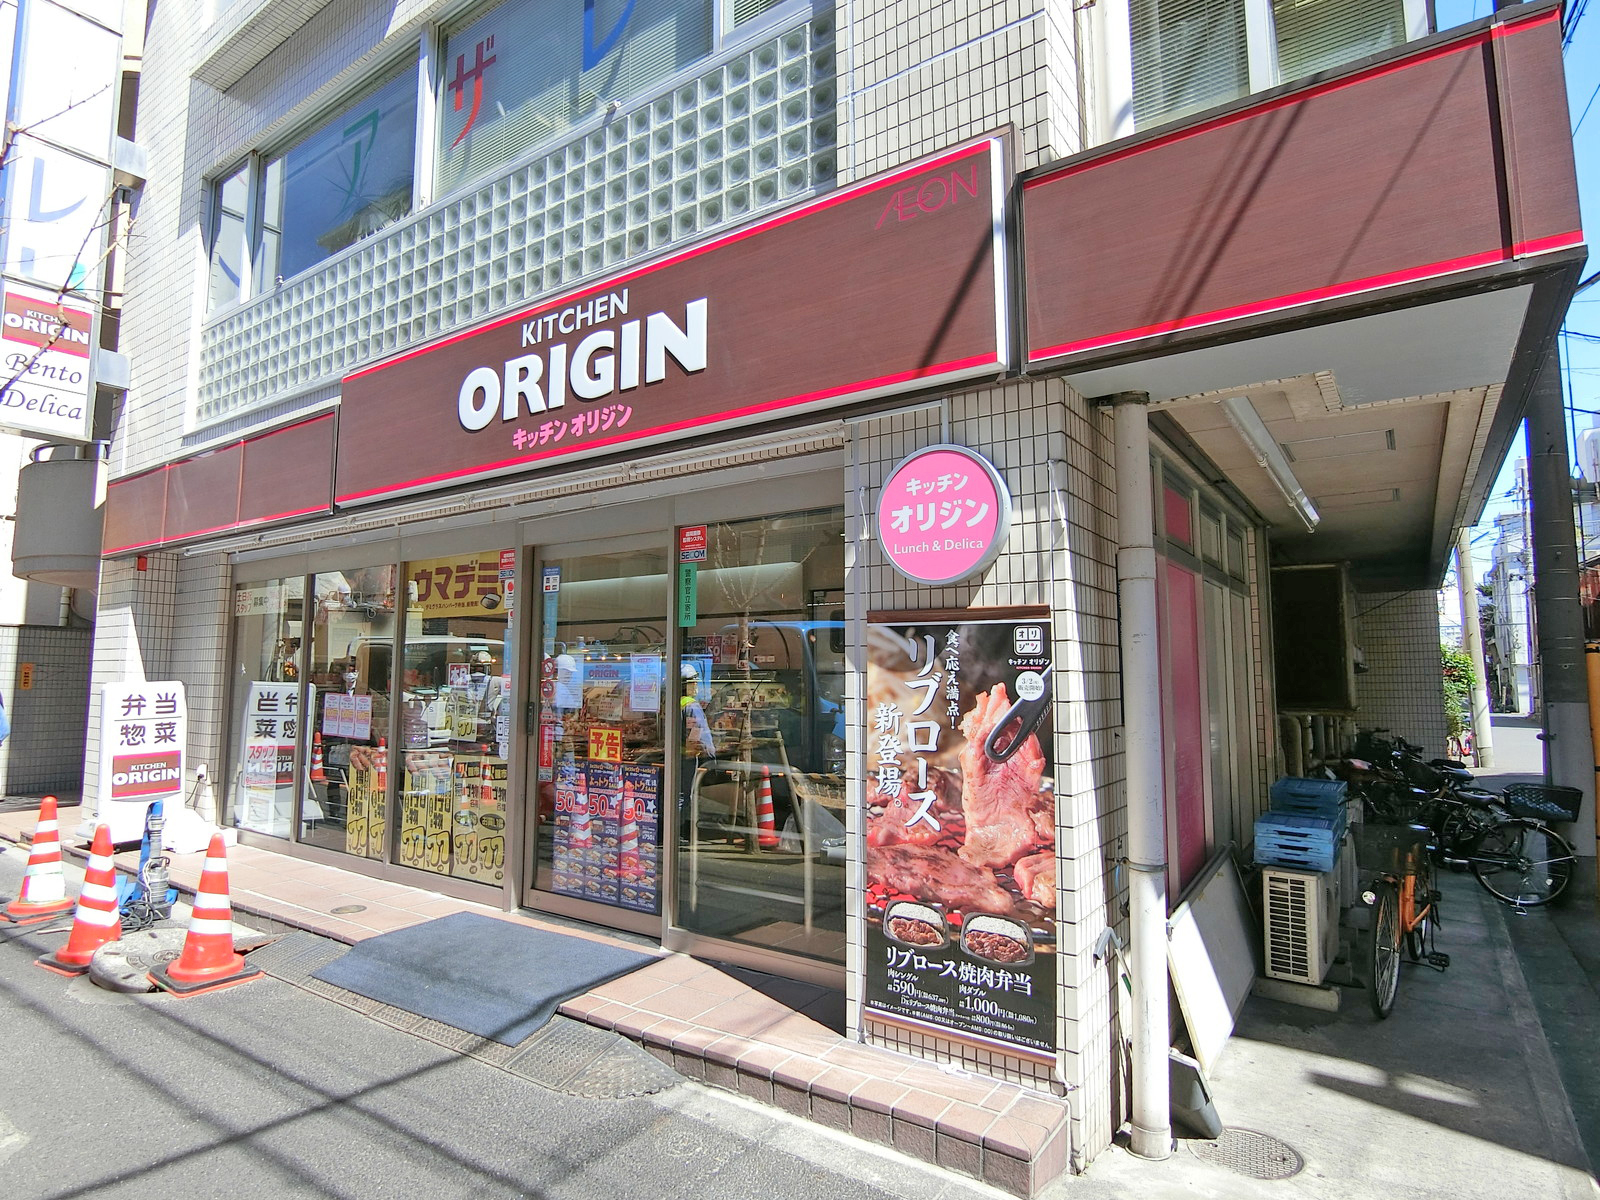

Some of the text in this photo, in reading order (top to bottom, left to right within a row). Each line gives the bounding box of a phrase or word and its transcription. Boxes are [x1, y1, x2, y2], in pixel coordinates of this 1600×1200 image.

[448, 34, 497, 151] ザ
[26, 309, 63, 325] KITCH
[521, 287, 629, 348] KITCHEN
[5, 352, 82, 384] Bento
[458, 297, 708, 431] ORIGIN
[2, 388, 83, 420] Delica
[905, 472, 969, 496] キッチン
[890, 498, 989, 534] オリジン
[681, 549, 705, 560] SECOM
[893, 537, 984, 555] Lunch & Delica
[500, 569, 515, 578] SECO
[683, 568, 692, 621] 警察官立寄所
[589, 669, 619, 677] ORIGIN
[121, 692, 177, 716] 弁当
[119, 721, 177, 746] 惣菜
[590, 731, 620, 758] 予告
[904, 634, 943, 834] リブロース
[112, 767, 180, 786] ORIGIN
[131, 761, 167, 771] KITCHEN
[886, 945, 1033, 997] リブロース焼肉弁当
